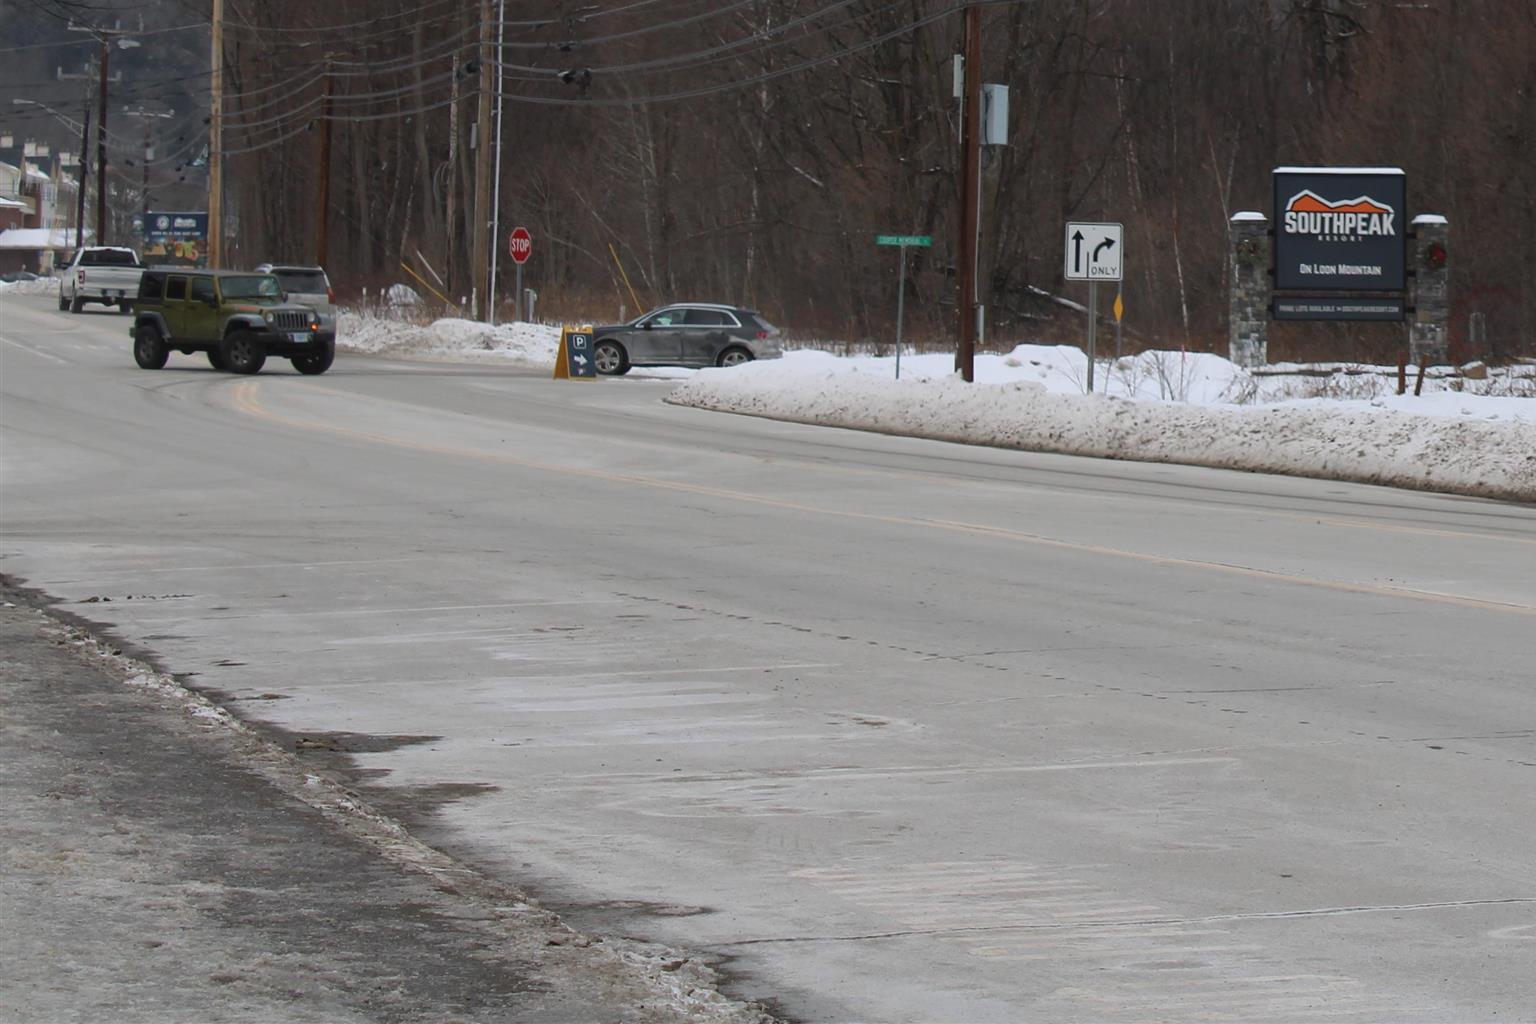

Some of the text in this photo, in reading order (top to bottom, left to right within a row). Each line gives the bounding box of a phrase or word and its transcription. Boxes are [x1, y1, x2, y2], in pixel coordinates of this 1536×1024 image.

[1285, 211, 1395, 235] SOUTHPEAK
[511, 238, 530, 252] STOP
[1091, 266, 1117, 275] ONLY
